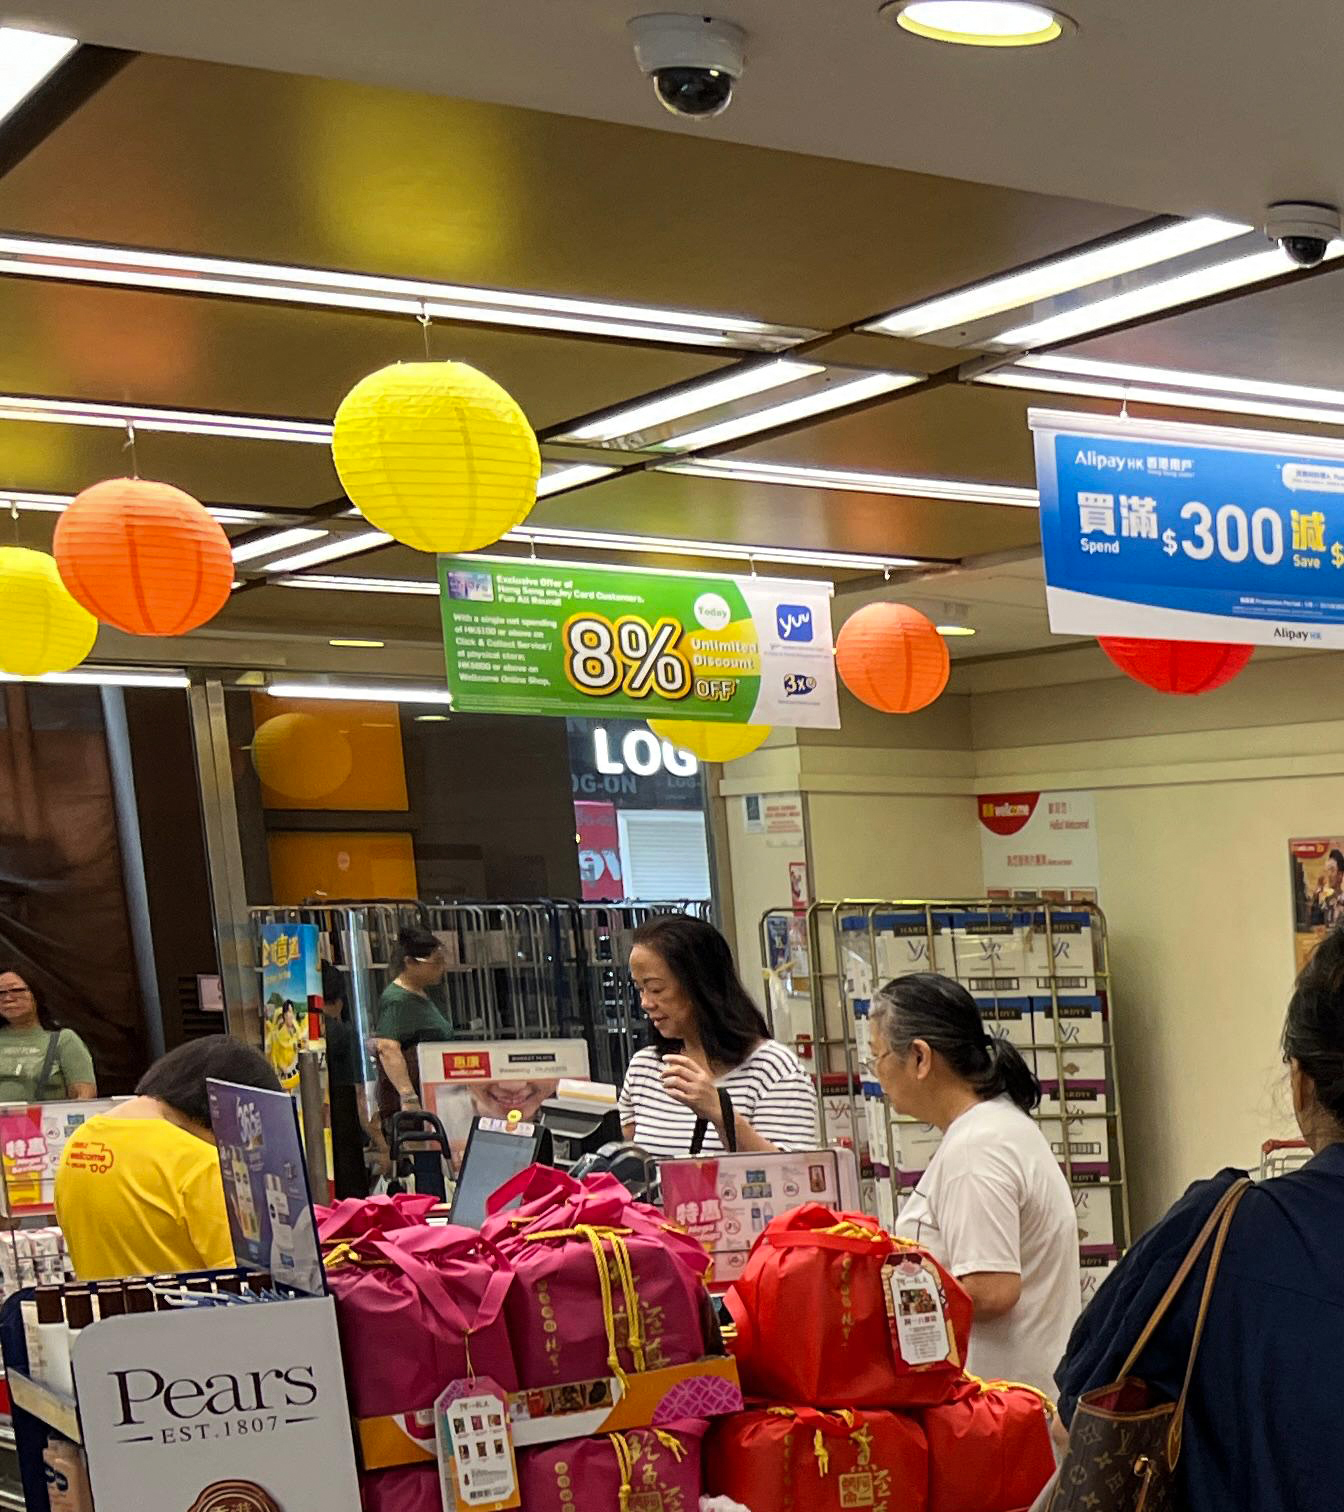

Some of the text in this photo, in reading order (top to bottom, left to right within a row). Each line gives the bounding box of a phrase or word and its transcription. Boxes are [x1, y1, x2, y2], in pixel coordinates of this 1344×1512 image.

[1075, 451, 1144, 471] Alipay HK
[1078, 491, 1158, 539] 買滿
[1162, 501, 1283, 565] $300
[1290, 510, 1326, 551] 減
[1080, 538, 1120, 554] Spend
[1293, 554, 1321, 569] Save
[698, 607, 728, 618] Today
[778, 612, 810, 638] yuu
[1273, 627, 1309, 641] Alipay
[567, 617, 687, 694] 8%
[691, 638, 759, 655] Unlimited
[693, 656, 754, 669] Discount
[107, 1366, 318, 1427] Pears
[161, 1416, 278, 1444] EST.1807
